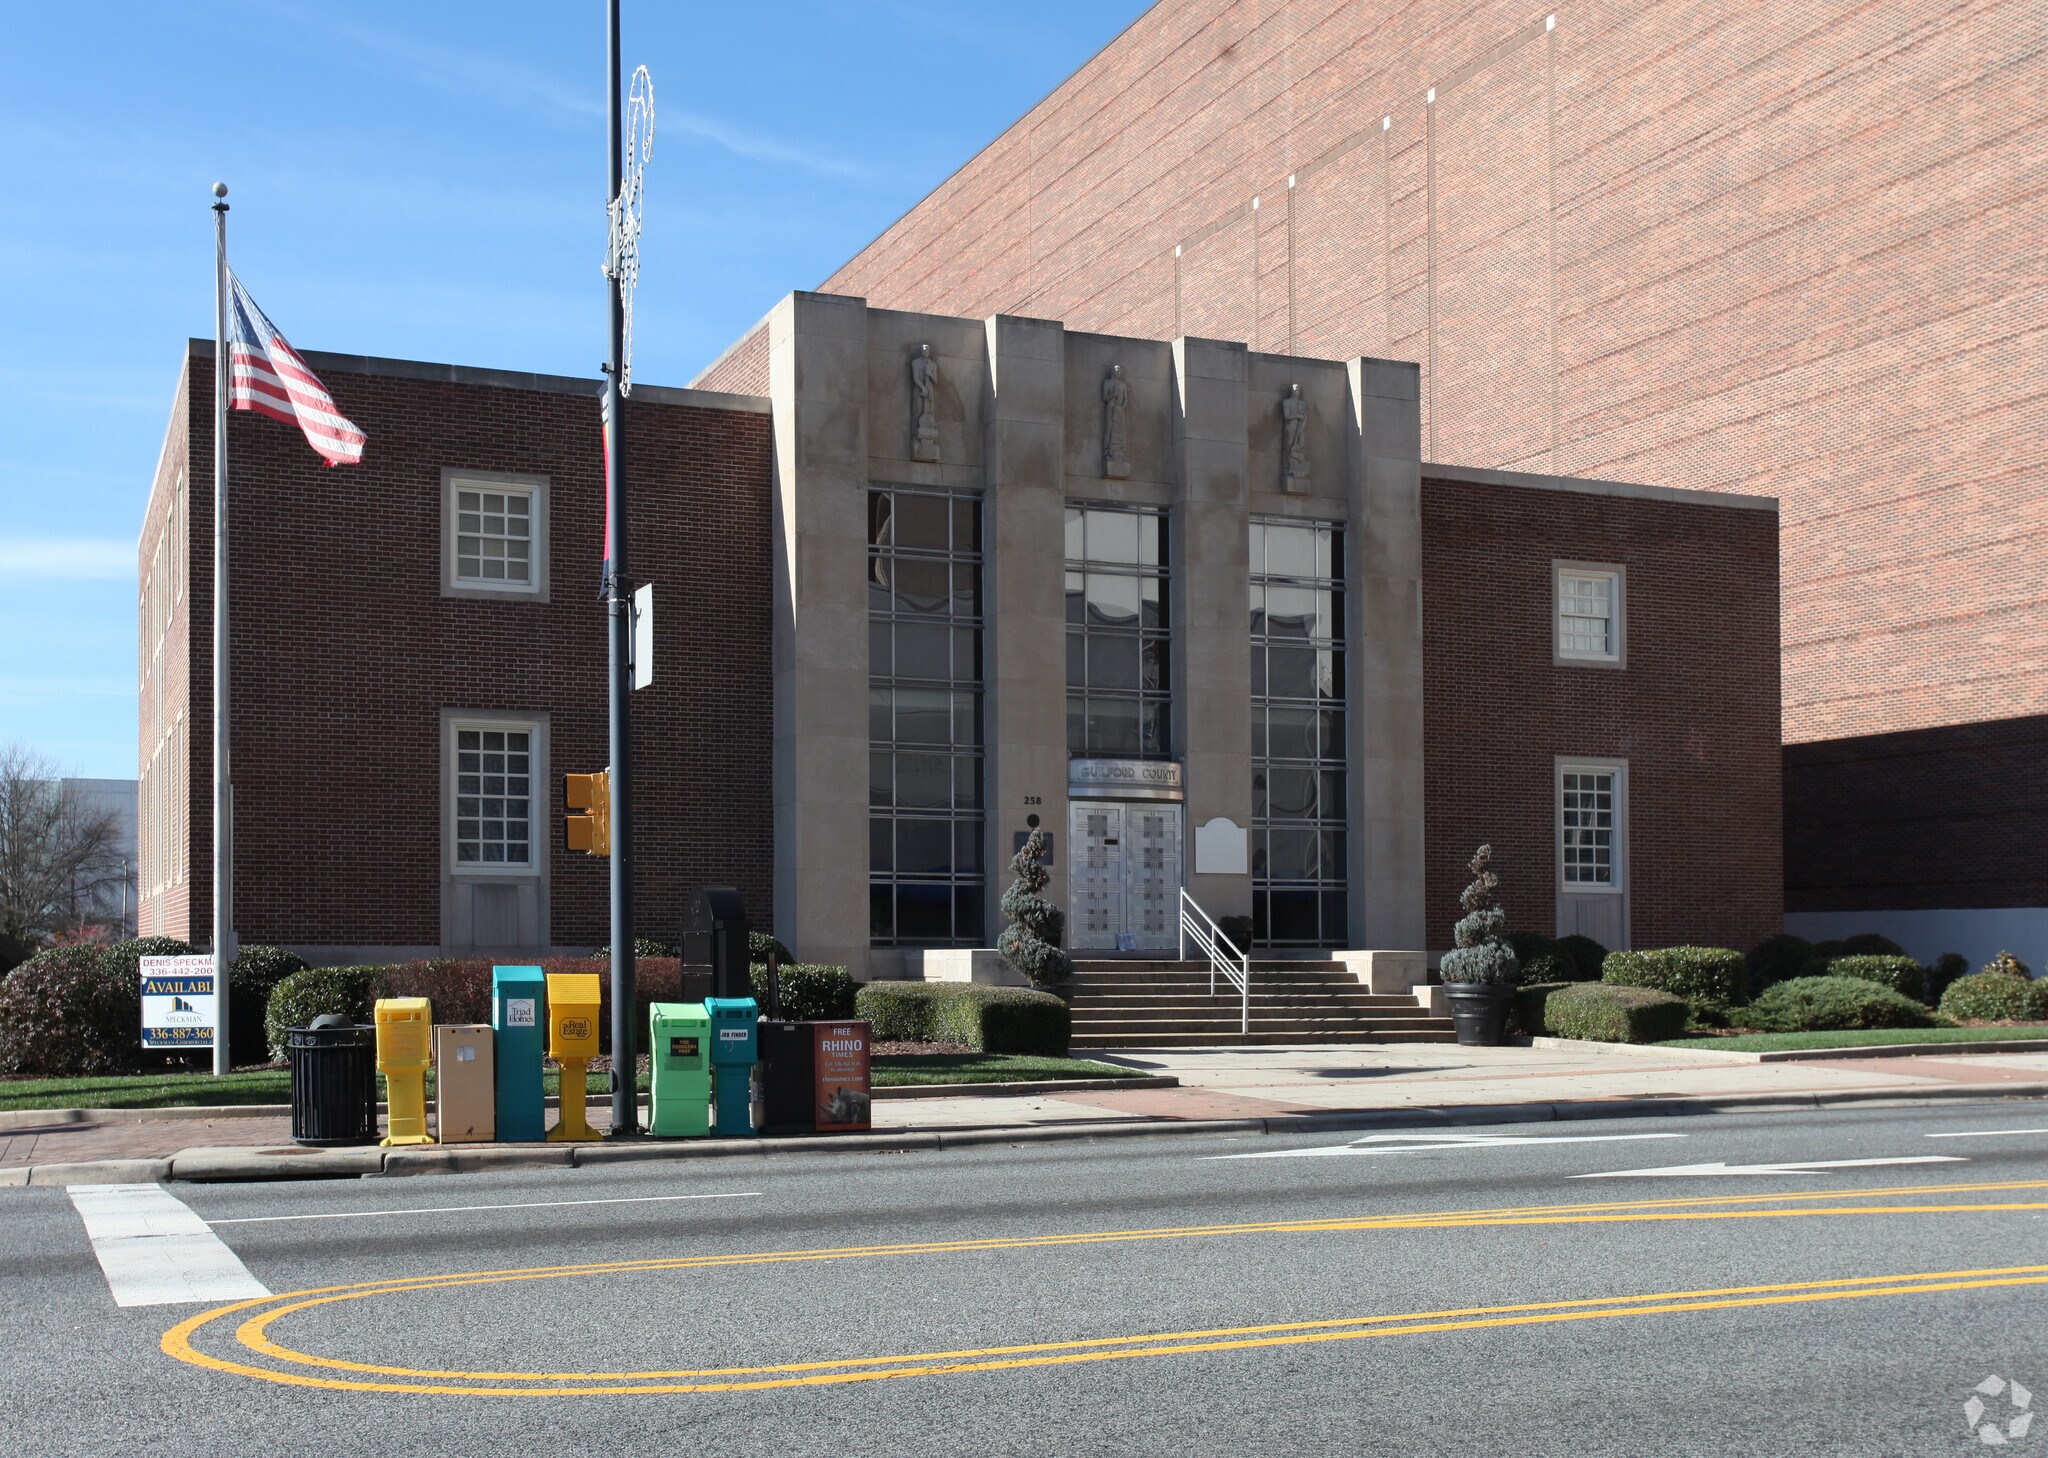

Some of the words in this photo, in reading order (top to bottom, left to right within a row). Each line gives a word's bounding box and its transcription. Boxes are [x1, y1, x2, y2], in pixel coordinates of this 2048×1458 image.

[1080, 767, 1135, 778] GUILFORD
[1142, 768, 1177, 780] COUNTY
[1024, 796, 1042, 805] 258
[143, 959, 171, 967] DENIS
[174, 958, 214, 967] SPECKM
[149, 967, 214, 976] 336-442-200
[146, 980, 214, 993] AVAILABL
[512, 1007, 531, 1015] Triad
[165, 1014, 203, 1023] SPECKMAN
[509, 1014, 534, 1023] Homes
[569, 1020, 587, 1028] Real
[149, 1027, 214, 1039] 336-887-360
[833, 1028, 851, 1036] FREE
[822, 1040, 863, 1052] RHINO
